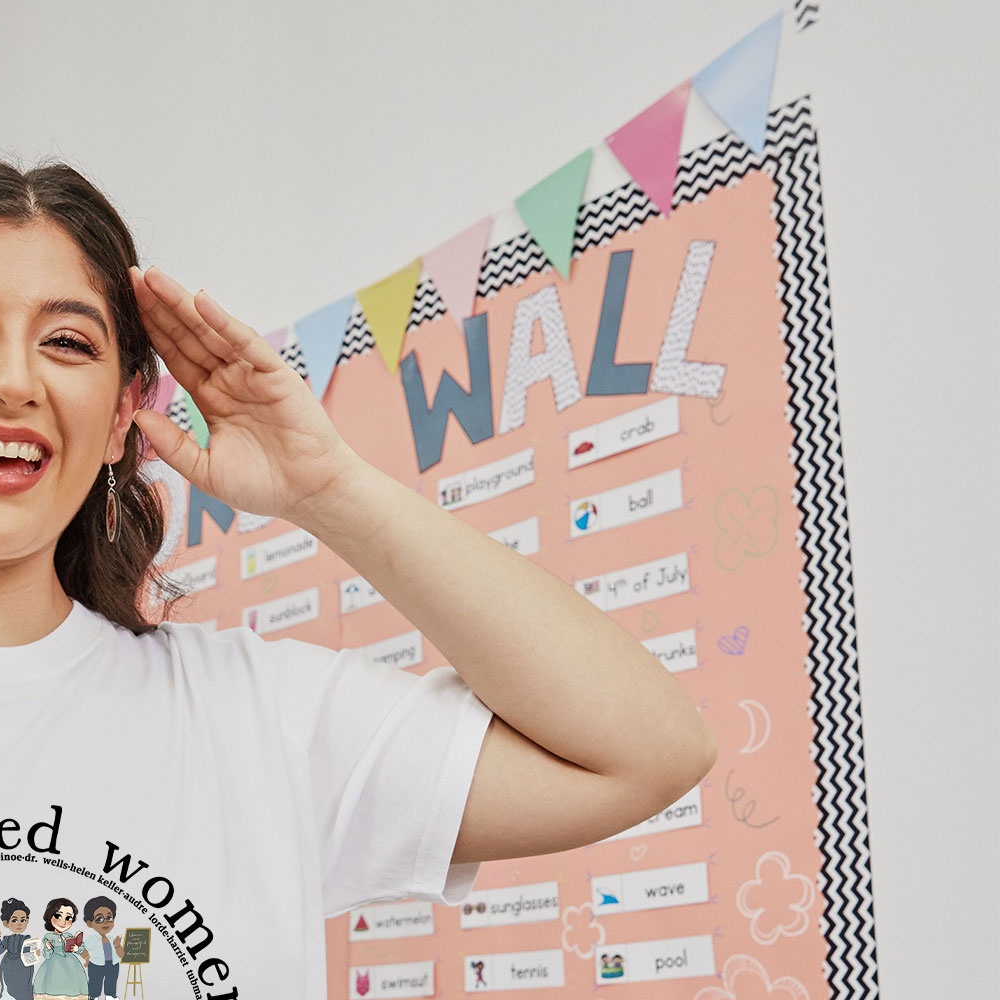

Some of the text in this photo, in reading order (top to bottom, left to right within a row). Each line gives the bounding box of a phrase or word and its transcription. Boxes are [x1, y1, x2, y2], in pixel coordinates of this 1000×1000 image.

[400, 240, 727, 473] WALL
[620, 417, 655, 442] crab
[629, 489, 653, 512] ball
[634, 572, 650, 593] of
[657, 565, 689, 587] July
[644, 881, 686, 898] wave
[489, 895, 559, 917] sunglasses
[510, 966, 549, 980] tennis
[654, 948, 689, 974] pool
